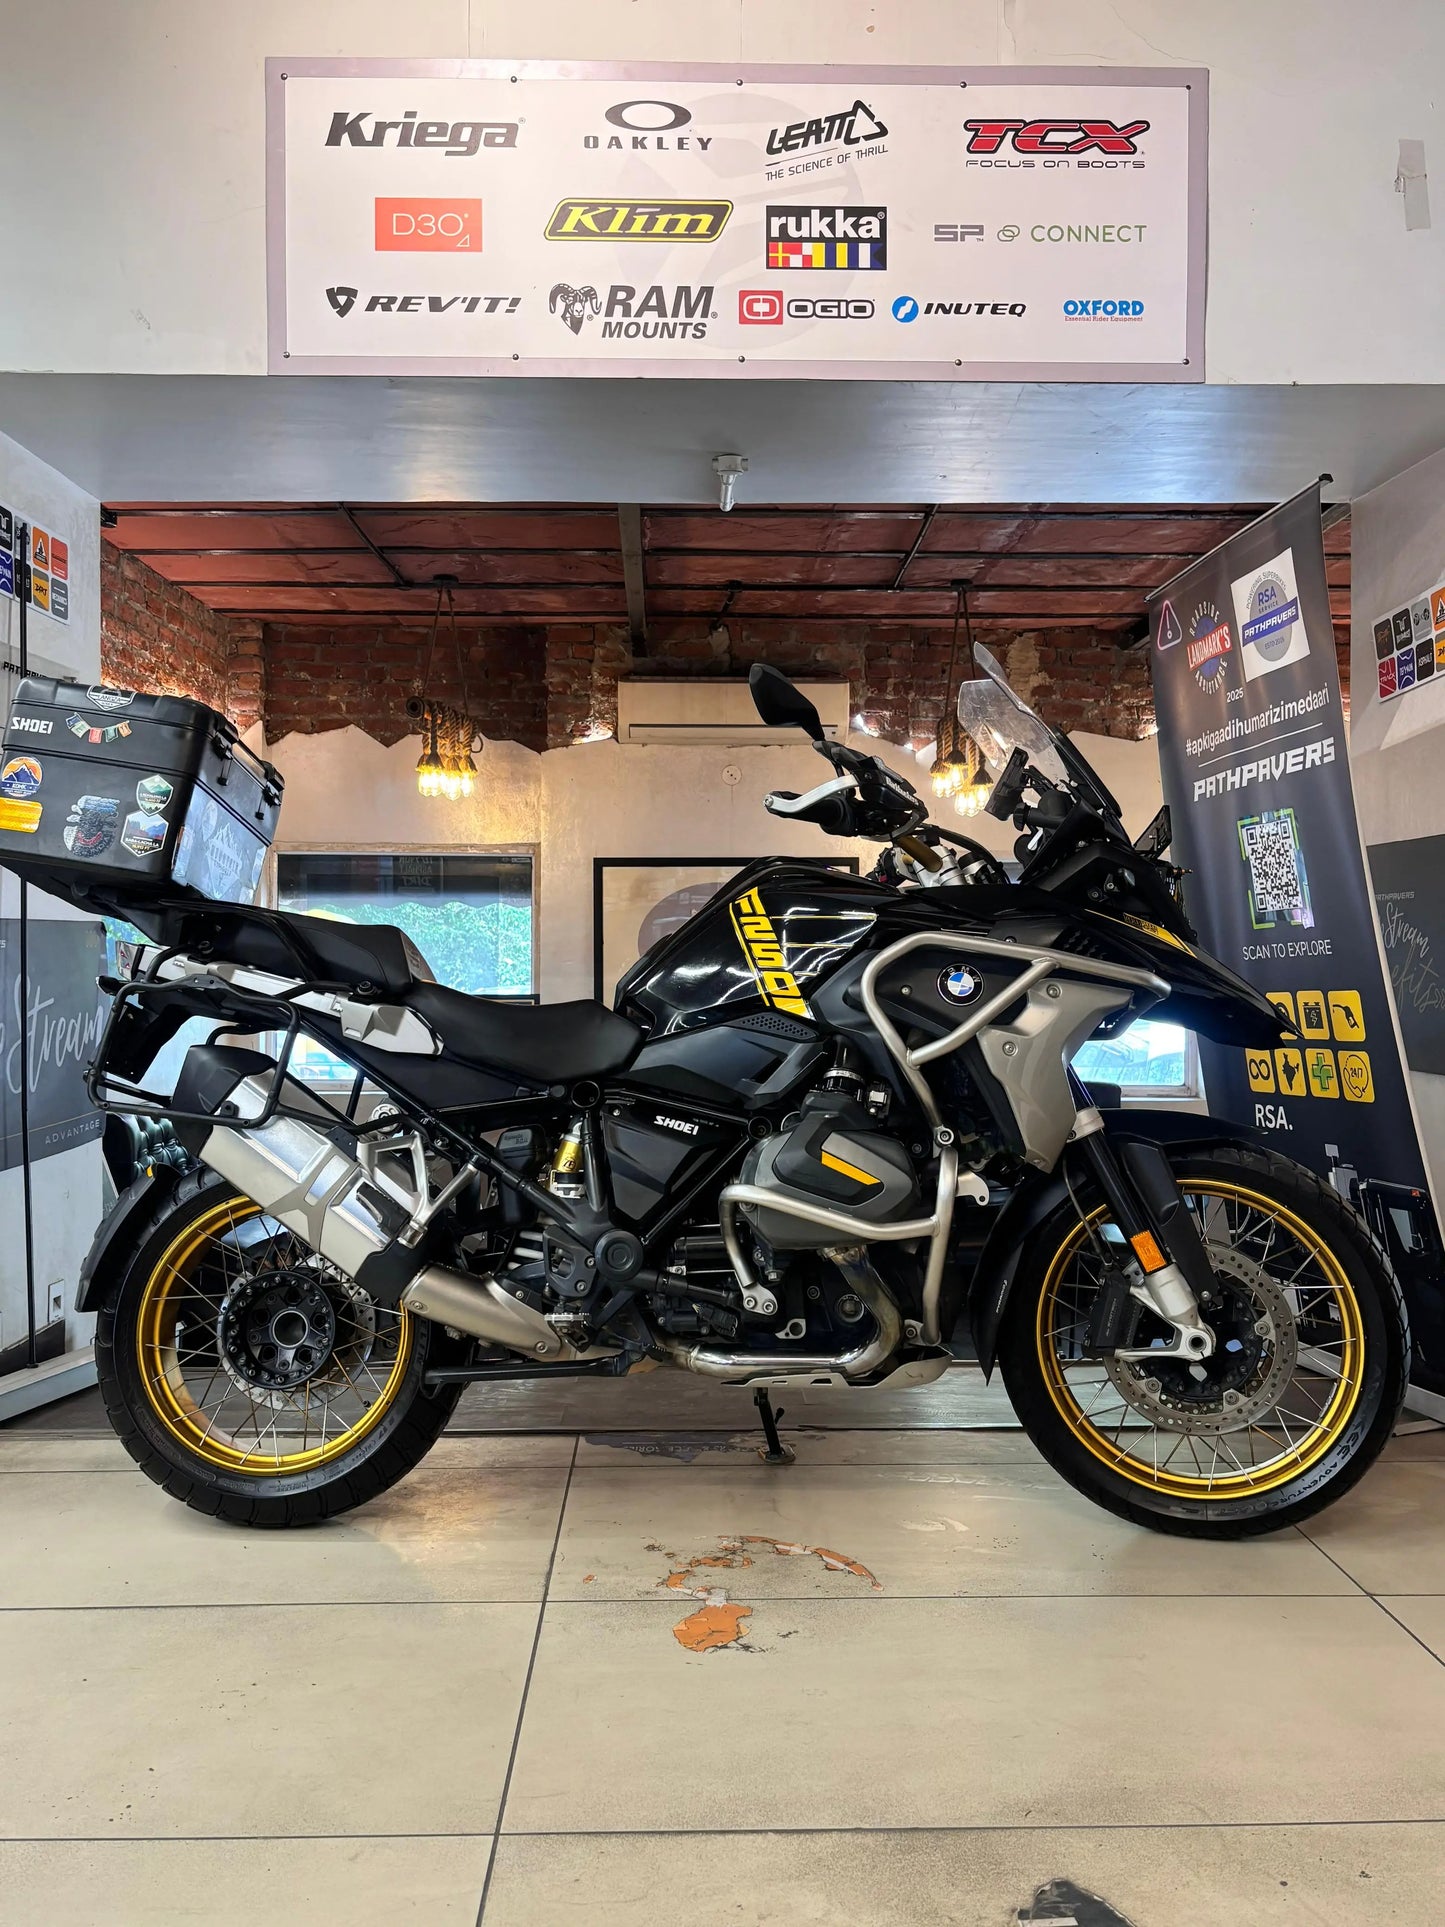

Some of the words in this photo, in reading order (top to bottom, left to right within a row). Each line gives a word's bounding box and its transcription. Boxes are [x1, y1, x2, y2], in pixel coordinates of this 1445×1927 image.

[324, 110, 520, 157] Kriega
[583, 135, 713, 151] OAKLEY
[963, 118, 1151, 156] TCX
[765, 170, 784, 181] THE
[788, 158, 833, 177] SCIENCE
[837, 153, 852, 165] OF
[855, 144, 889, 160] THRILL
[965, 159, 1036, 169] FOCUS
[1077, 159, 1146, 169] BOOTS
[770, 207, 881, 239] rukka
[933, 223, 985, 243] SP
[1030, 224, 1148, 244] CONNECT
[364, 295, 522, 314] REV'IT!
[604, 284, 715, 319] RAM
[786, 298, 876, 320] OGIO
[923, 301, 1027, 319] INUTEQ
[1062, 299, 1145, 316] OXFORD
[601, 321, 708, 340] MOUNTS
[1257, 585, 1277, 607] RSA
[1258, 600, 1279, 615] SERVICE
[1189, 600, 1221, 637] ROADSIDE
[1244, 606, 1297, 639] PATHPAVERS
[1186, 626, 1232, 670] LANDMARK'S
[1226, 687, 1244, 703] 2025
[10, 716, 54, 735] SHOEI
[1185, 682, 1330, 758] #apkigaadihumarizimedaari
[1193, 736, 1336, 802] PATHPAVERS
[1242, 945, 1270, 961] SCAN
[1271, 943, 1286, 958] TO
[1288, 940, 1332, 958] EXPLORE
[947, 965, 981, 984] BMW
[1349, 1066, 1363, 1080] 24/7
[653, 1115, 700, 1136] SHOEI
[1254, 1103, 1294, 1132] RSA.
[45, 1118, 101, 1145] ADVANTAGE
